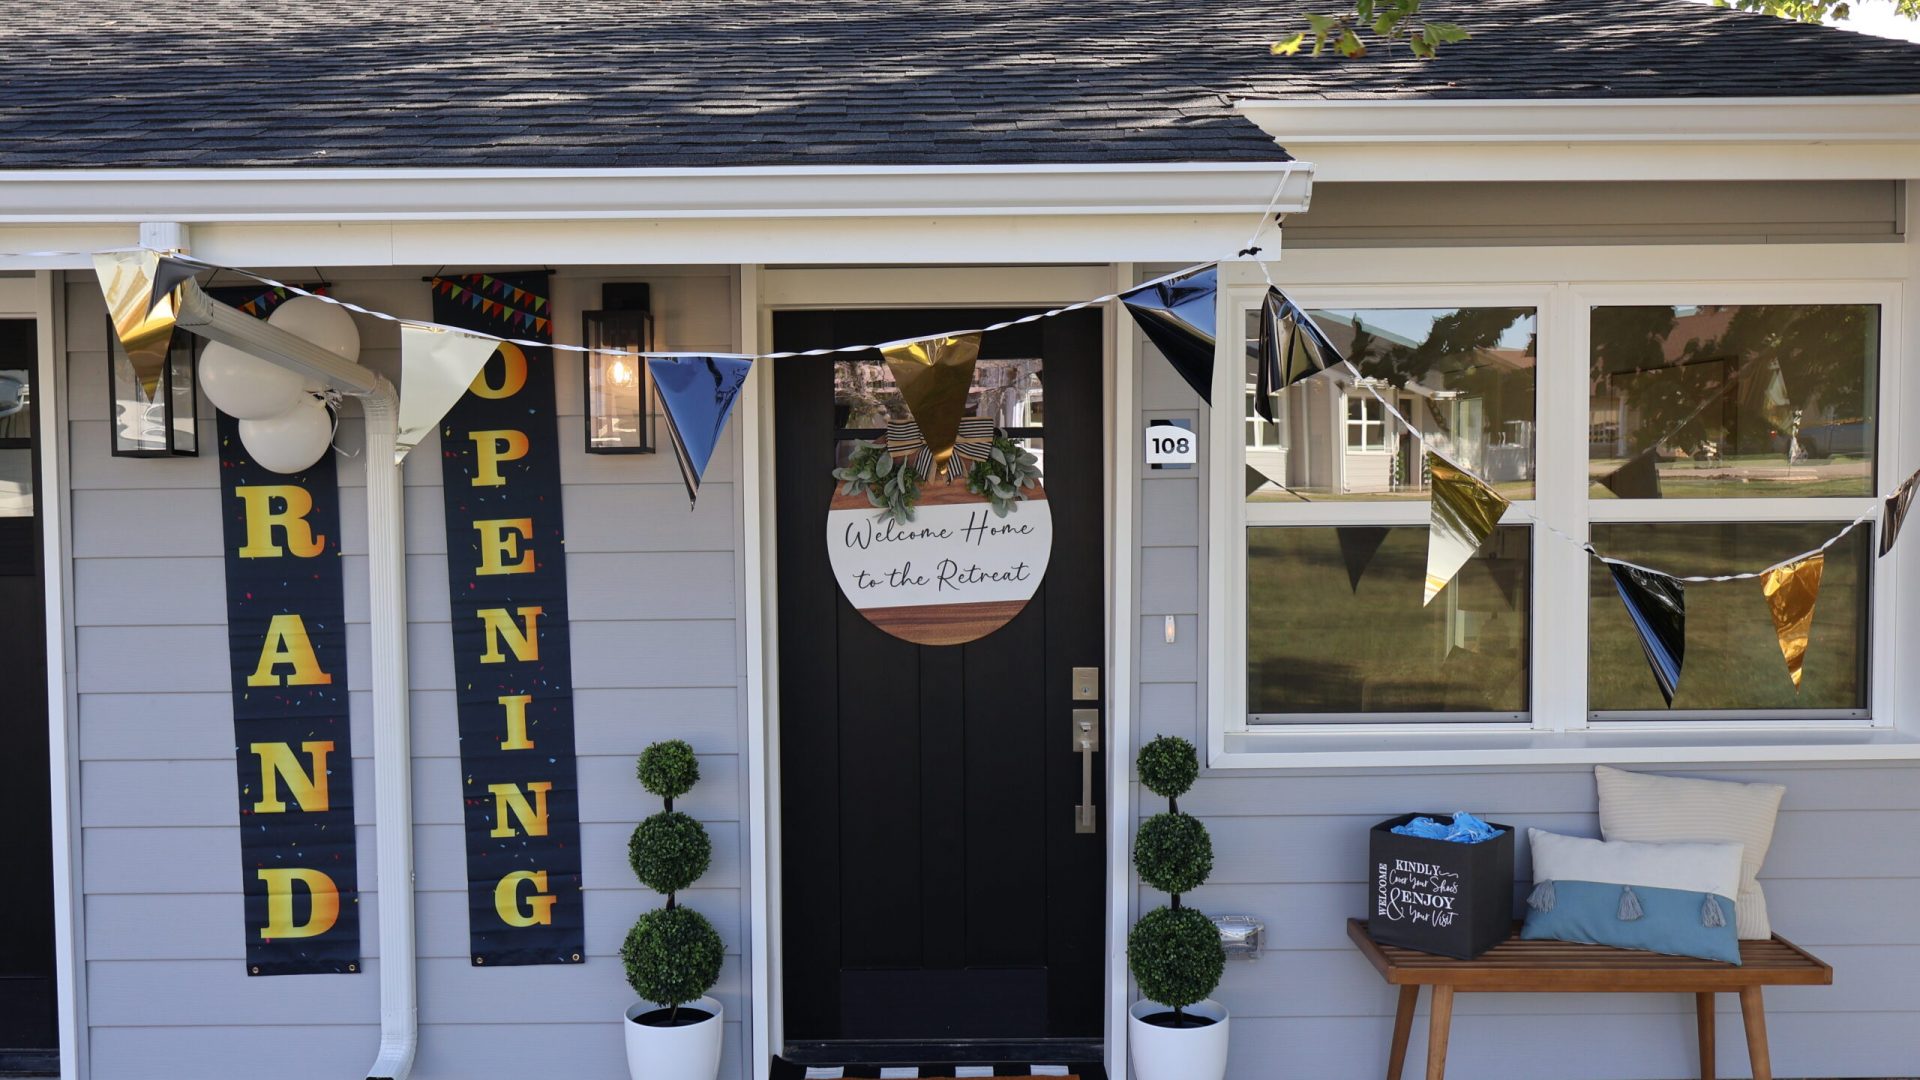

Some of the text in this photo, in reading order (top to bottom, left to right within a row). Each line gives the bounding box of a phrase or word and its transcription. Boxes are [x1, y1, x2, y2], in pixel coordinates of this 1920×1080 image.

[1152, 437, 1190, 454] 108
[845, 509, 1034, 550] Welcome Home
[852, 558, 1030, 592] to the Retreat
[467, 340, 558, 928] OPENING
[235, 484, 341, 939] RAND
[1395, 859, 1440, 876] KINDLY
[1378, 862, 1388, 916] WELCOME
[1409, 873, 1429, 890] Your
[1429, 875, 1459, 894] Shoes
[1401, 889, 1455, 910] ENJOY
[1409, 905, 1459, 928] Your Visit
